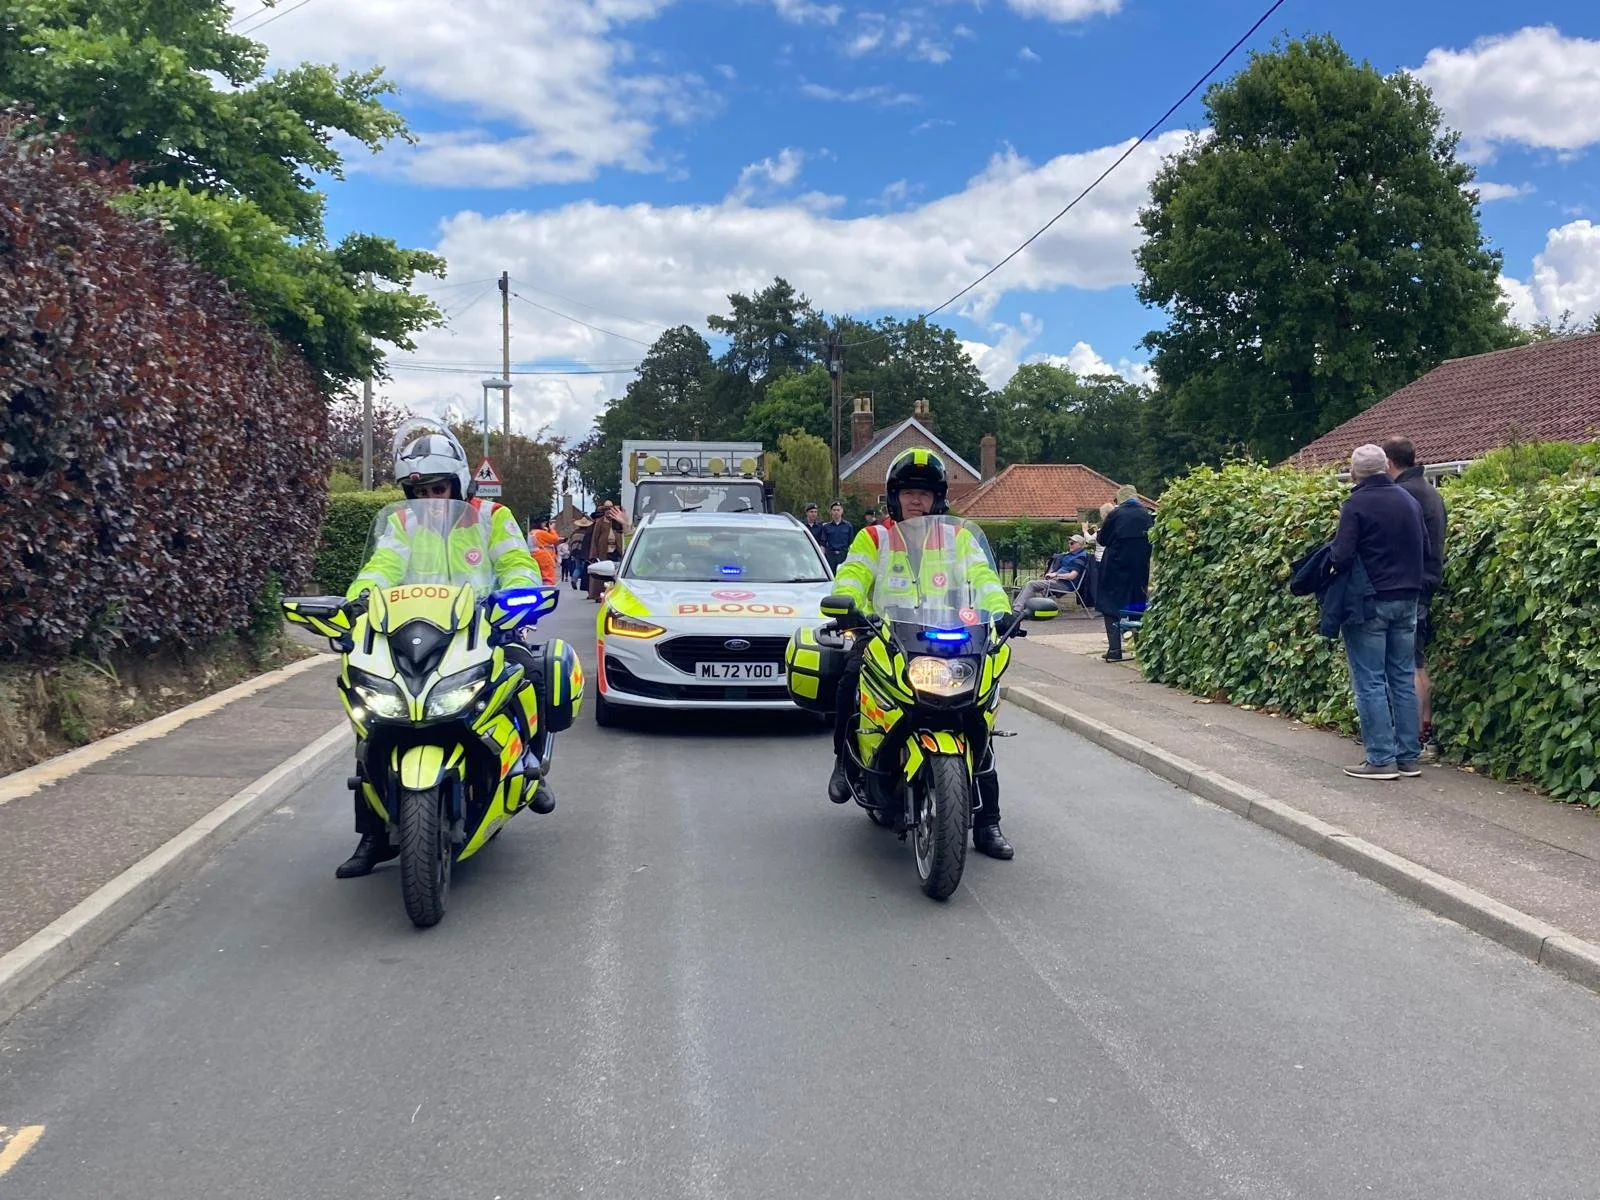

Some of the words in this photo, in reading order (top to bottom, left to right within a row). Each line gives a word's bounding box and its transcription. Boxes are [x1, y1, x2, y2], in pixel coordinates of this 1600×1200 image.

[390, 587, 450, 602] BLOOD
[678, 603, 794, 616] BLOOD
[701, 664, 740, 678] ML72
